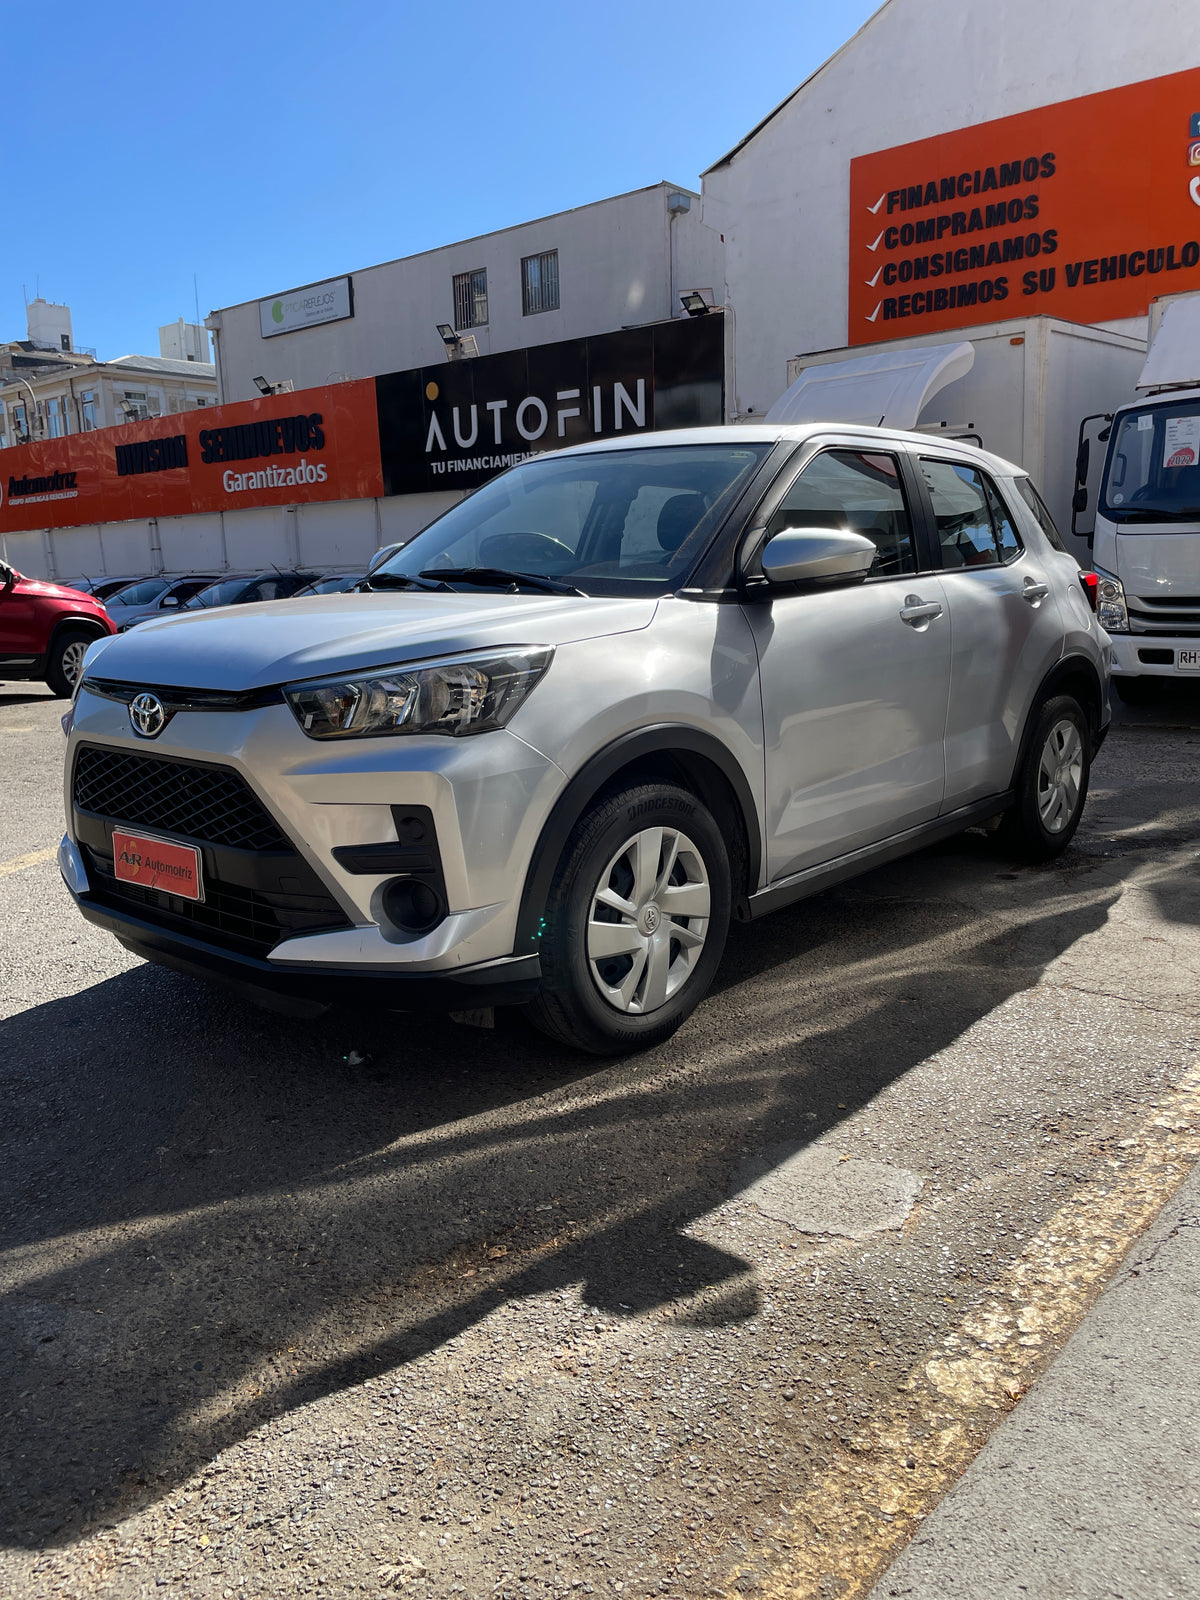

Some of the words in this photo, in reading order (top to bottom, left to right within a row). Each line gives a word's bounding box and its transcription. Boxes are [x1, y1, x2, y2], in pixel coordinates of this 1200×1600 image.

[886, 152, 1057, 214] FINANCIAMOS
[884, 195, 1040, 250] COMPRAMOS
[882, 229, 1059, 286] CONSIGNAMOS
[882, 276, 1009, 320] RECIBIMOS
[1022, 267, 1056, 296] SU
[1065, 241, 1200, 287] VEHICULO
[425, 378, 646, 452] AUTOFIN
[115, 434, 189, 477] DIVISION
[198, 413, 326, 464] SEMINUEVOS
[431, 461, 446, 475] TU
[448, 450, 547, 473] FINANCIAMIENT
[1170, 455, 1191, 466] 2022
[8, 470, 78, 498] Automotriz
[223, 459, 328, 493] Garantizados
[627, 797, 697, 822] BRIDGESTONE
[144, 856, 193, 880] Automotriz
